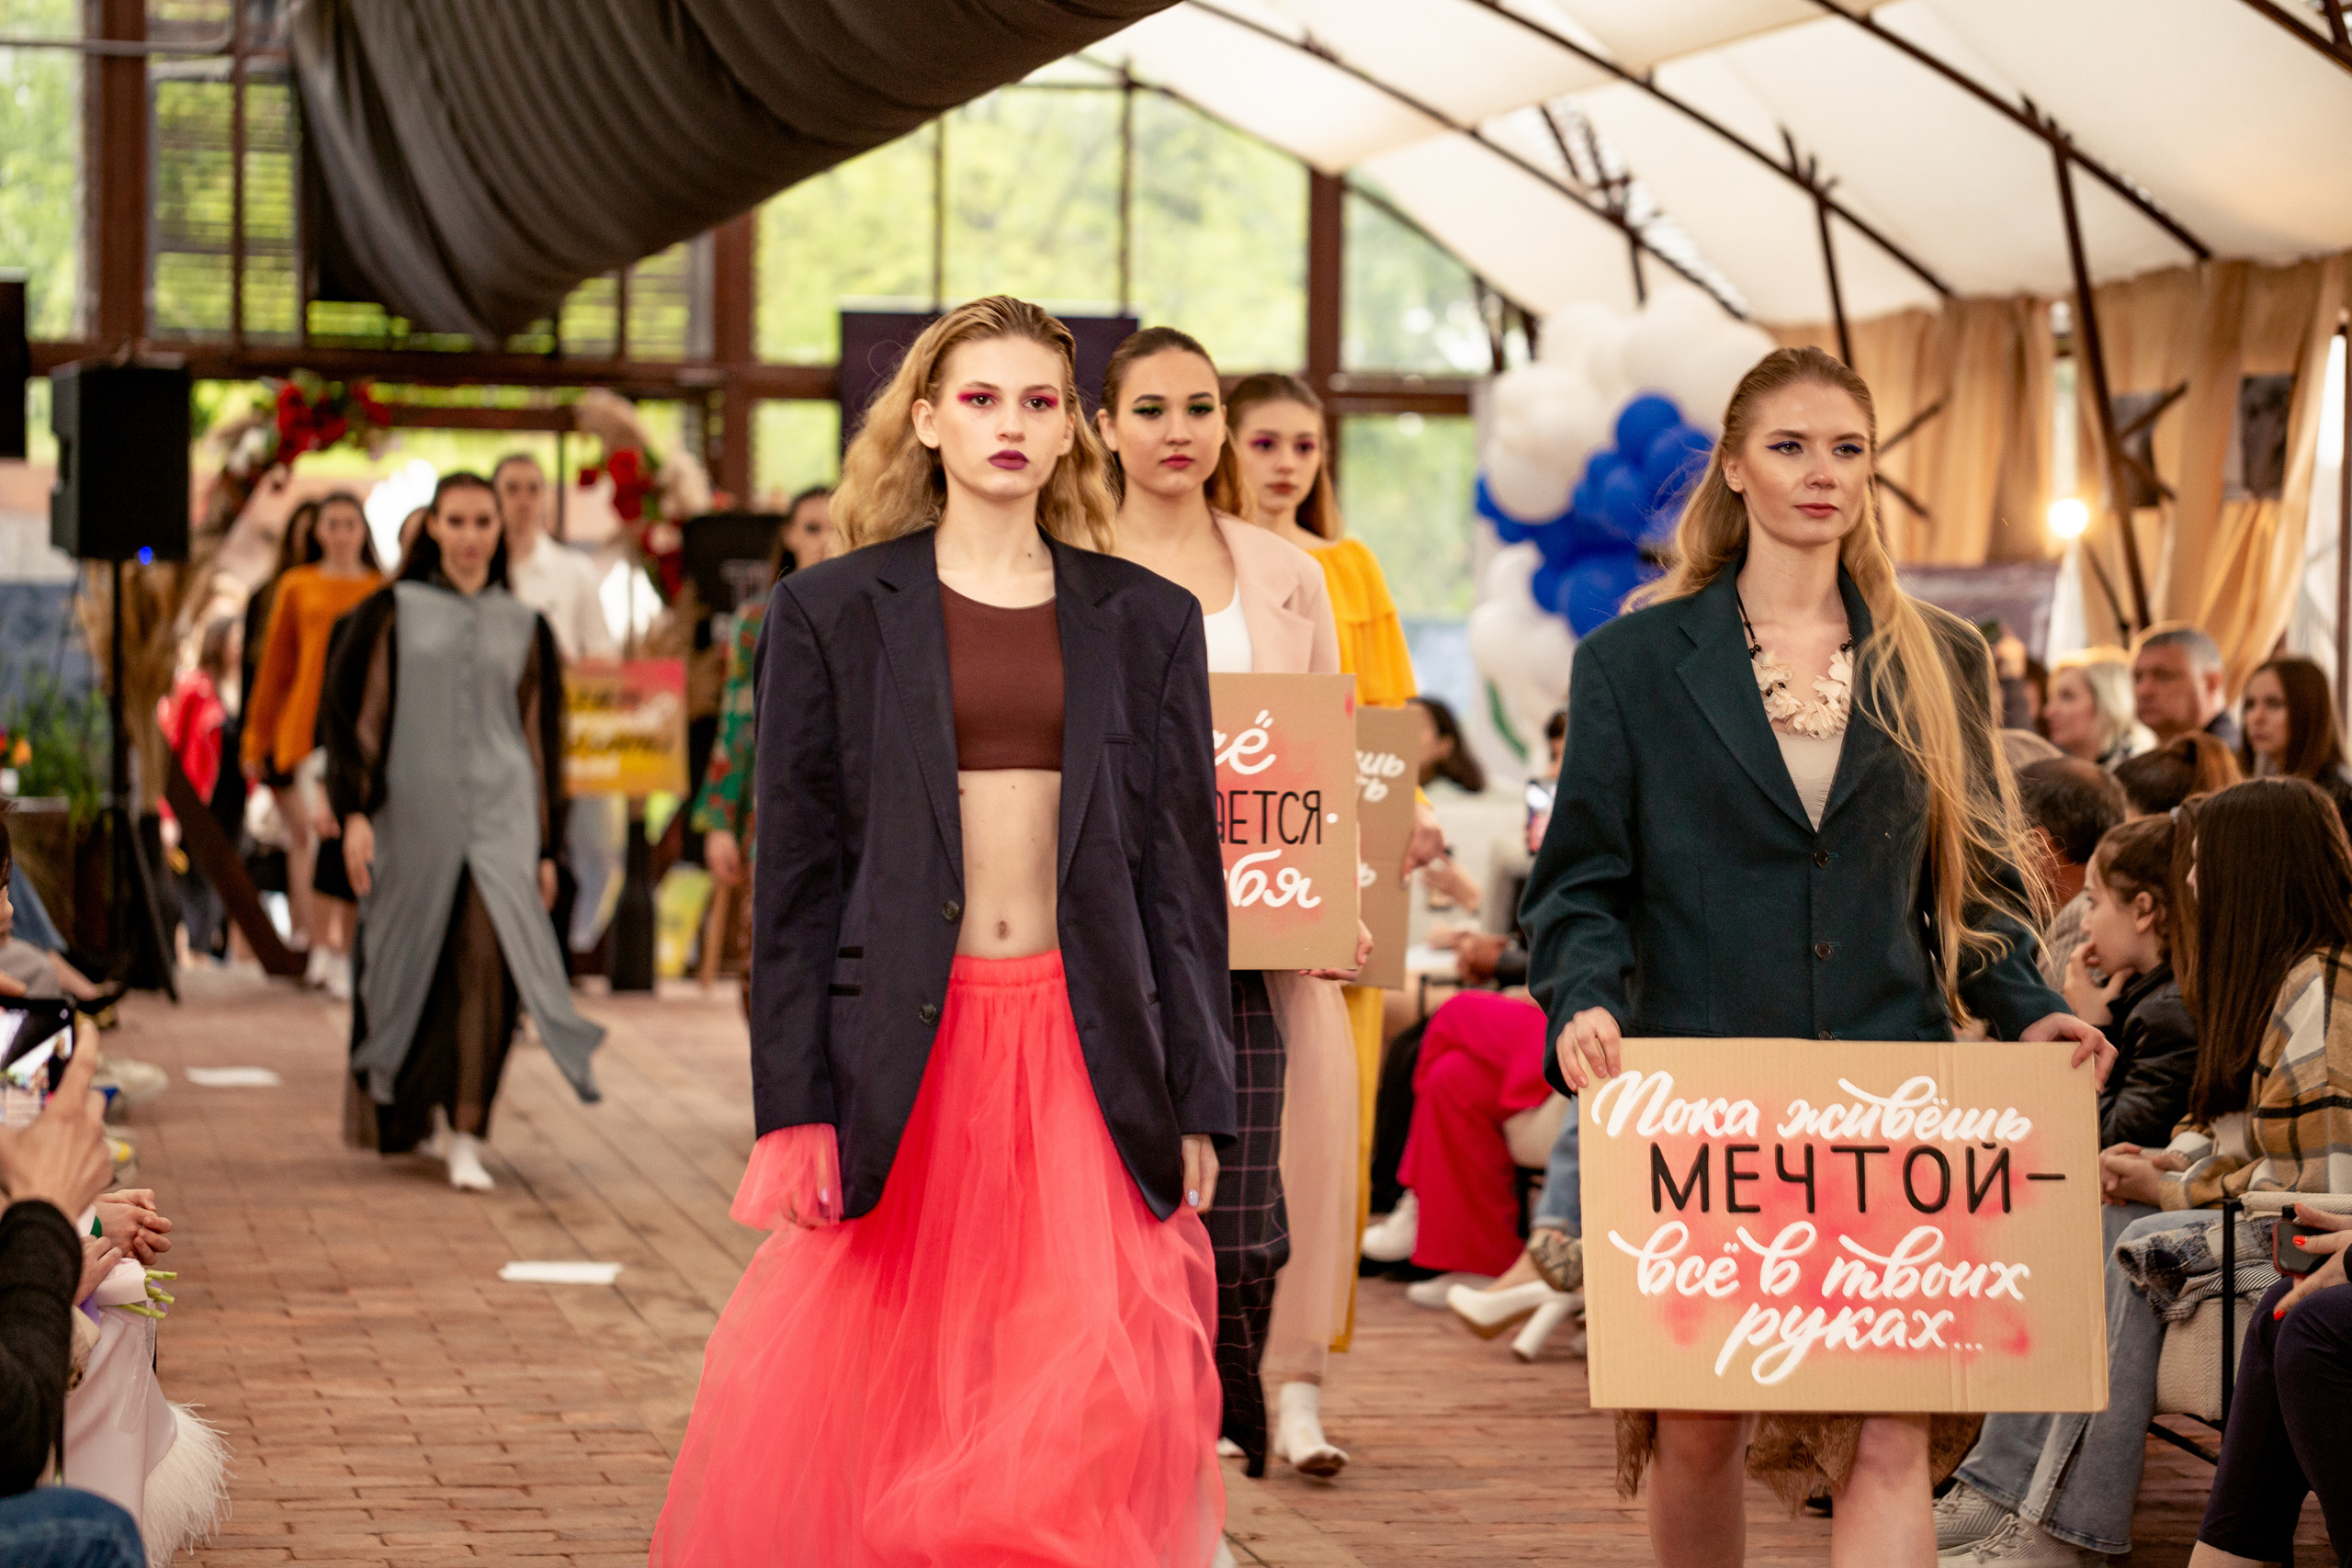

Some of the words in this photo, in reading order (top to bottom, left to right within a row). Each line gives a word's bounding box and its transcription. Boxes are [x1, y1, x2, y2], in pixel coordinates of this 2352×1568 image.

[1223, 848, 1322, 908] бя
[1591, 1070, 1758, 1138] Пока
[1778, 1076, 2032, 1141] живёшь
[1609, 1222, 1739, 1296] всё
[1736, 1221, 1817, 1296] в
[1821, 1225, 2031, 1301] твоих
